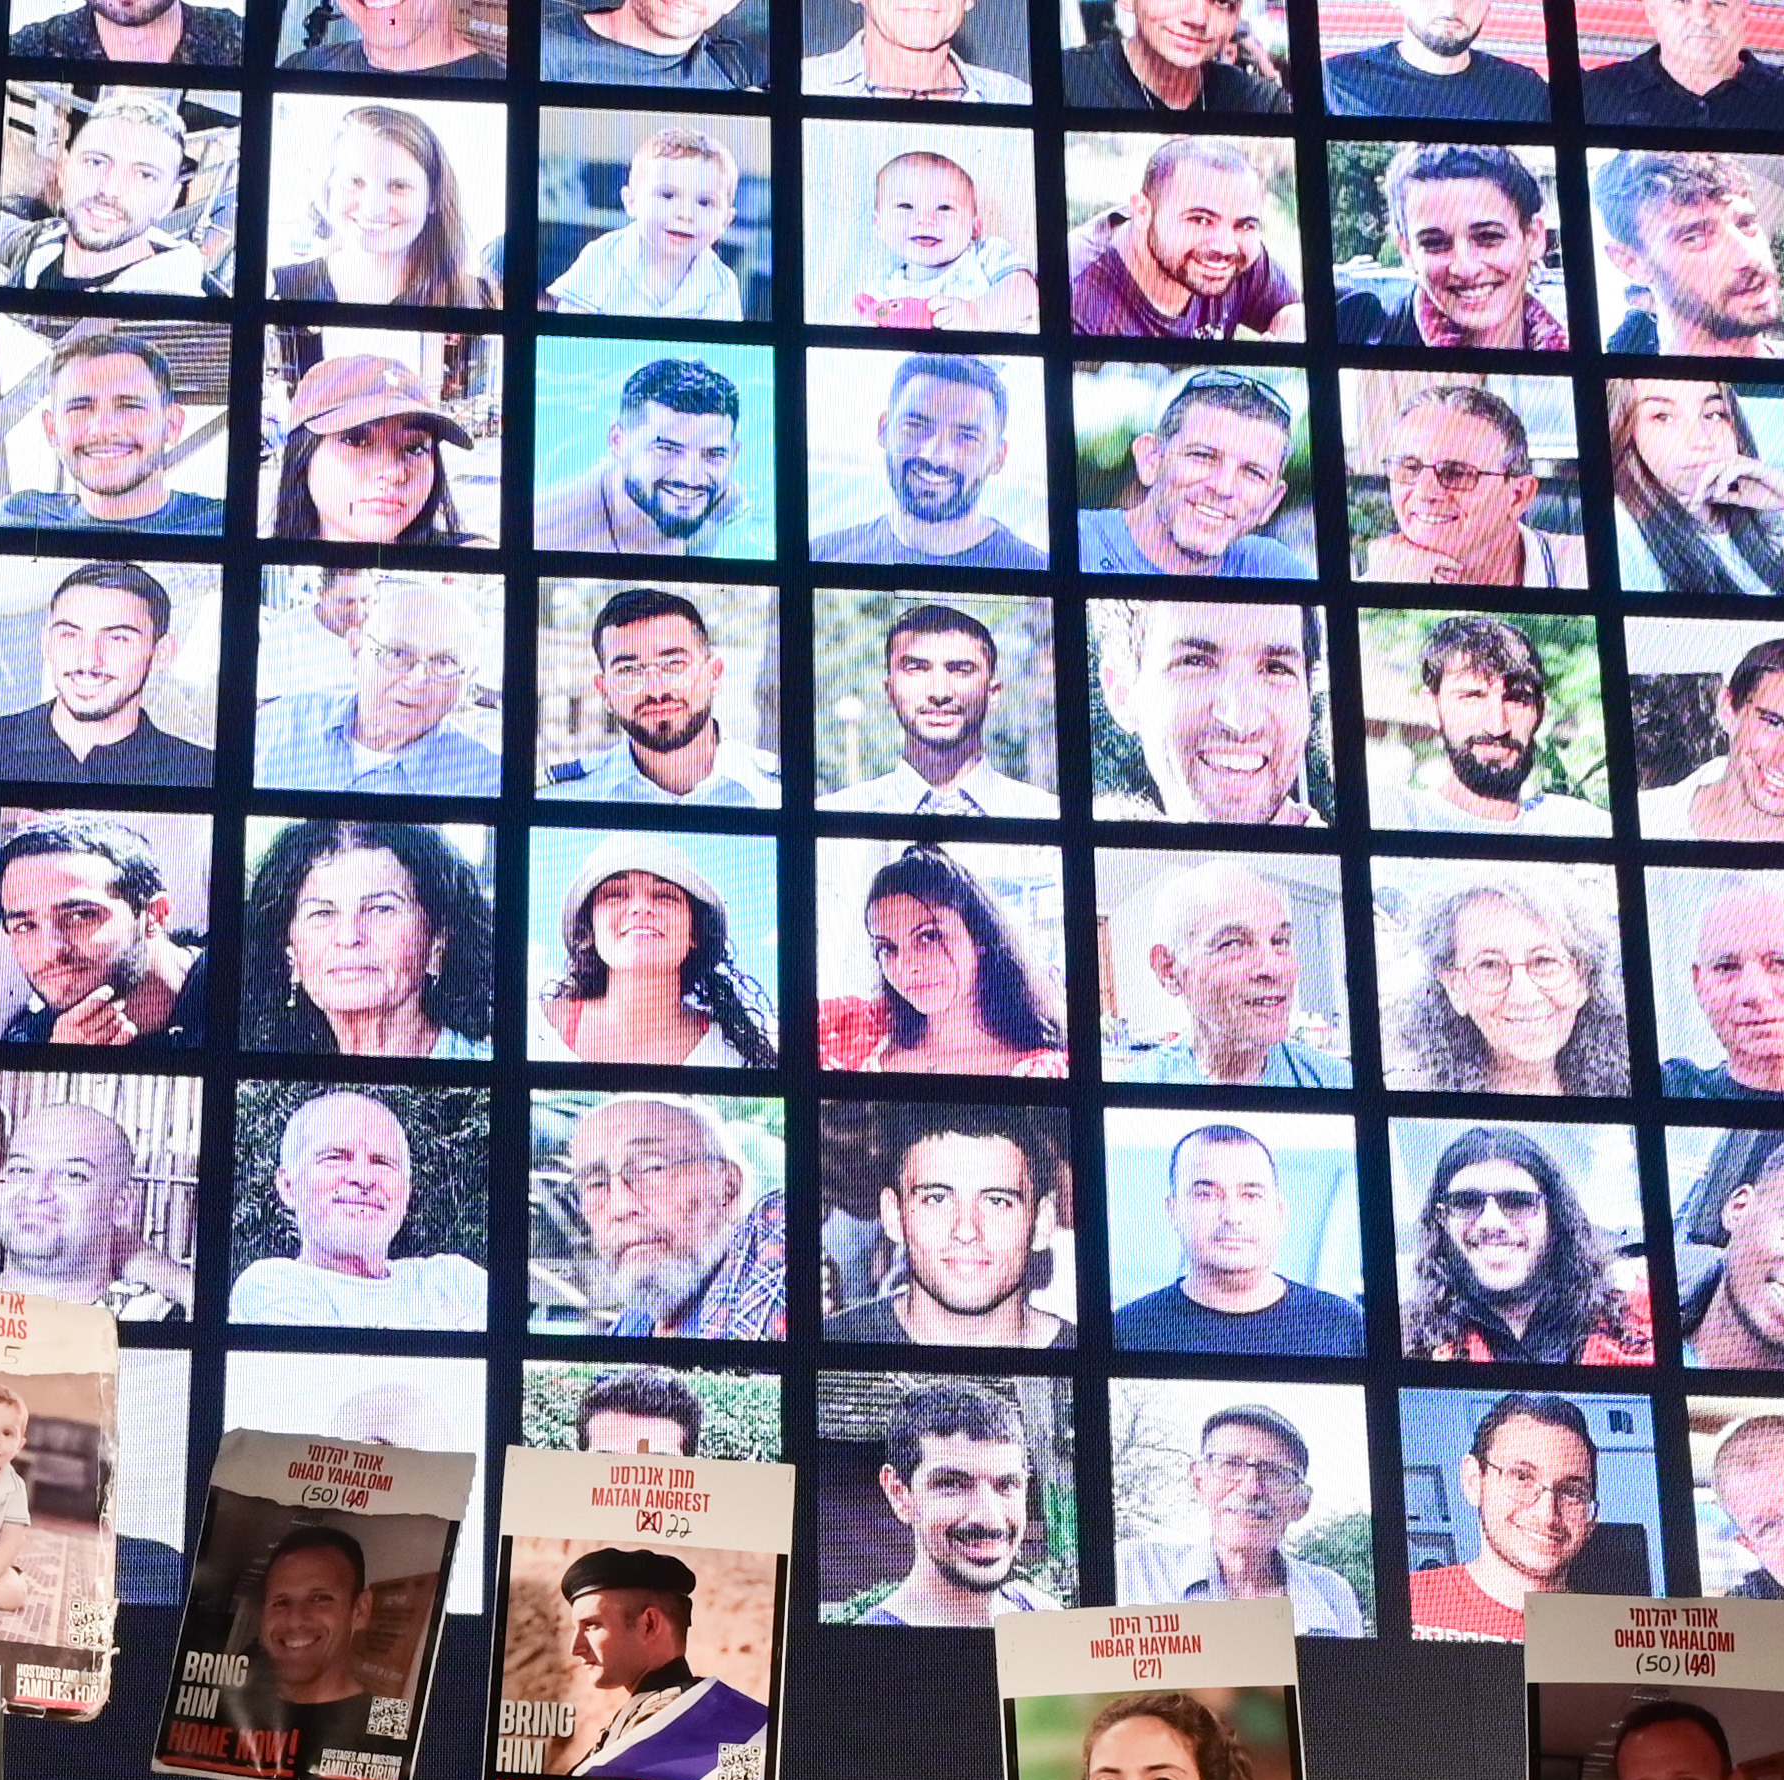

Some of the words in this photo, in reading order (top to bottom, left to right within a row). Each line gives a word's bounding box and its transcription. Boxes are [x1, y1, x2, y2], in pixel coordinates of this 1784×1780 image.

[308, 1444, 348, 1466] יהלומי
[353, 1451, 384, 1471] אוהד
[288, 1461, 323, 1482] OHAD
[327, 1466, 393, 1492] YAHALOMI
[610, 1465, 663, 1488] אנגרסט
[668, 1470, 695, 1489] מתן
[592, 1487, 641, 1508] MATAN
[645, 1490, 711, 1513] ANGREST
[1109, 1616, 1141, 1637] הימן
[1145, 1614, 1179, 1634] ענבר
[1629, 1607, 1677, 1627] יהלומי
[1681, 1608, 1719, 1628] אוהד
[1090, 1639, 1135, 1659] INBAR
[1140, 1635, 1202, 1655] HAYMAN
[1614, 1629, 1656, 1649] OHAD
[1661, 1630, 1735, 1653] YAHALOMI
[1133, 1658, 1162, 1680] (27)
[1636, 1654, 1680, 1675] (50)
[498, 1700, 575, 1738] BRING
[496, 1737, 544, 1774] HIM
